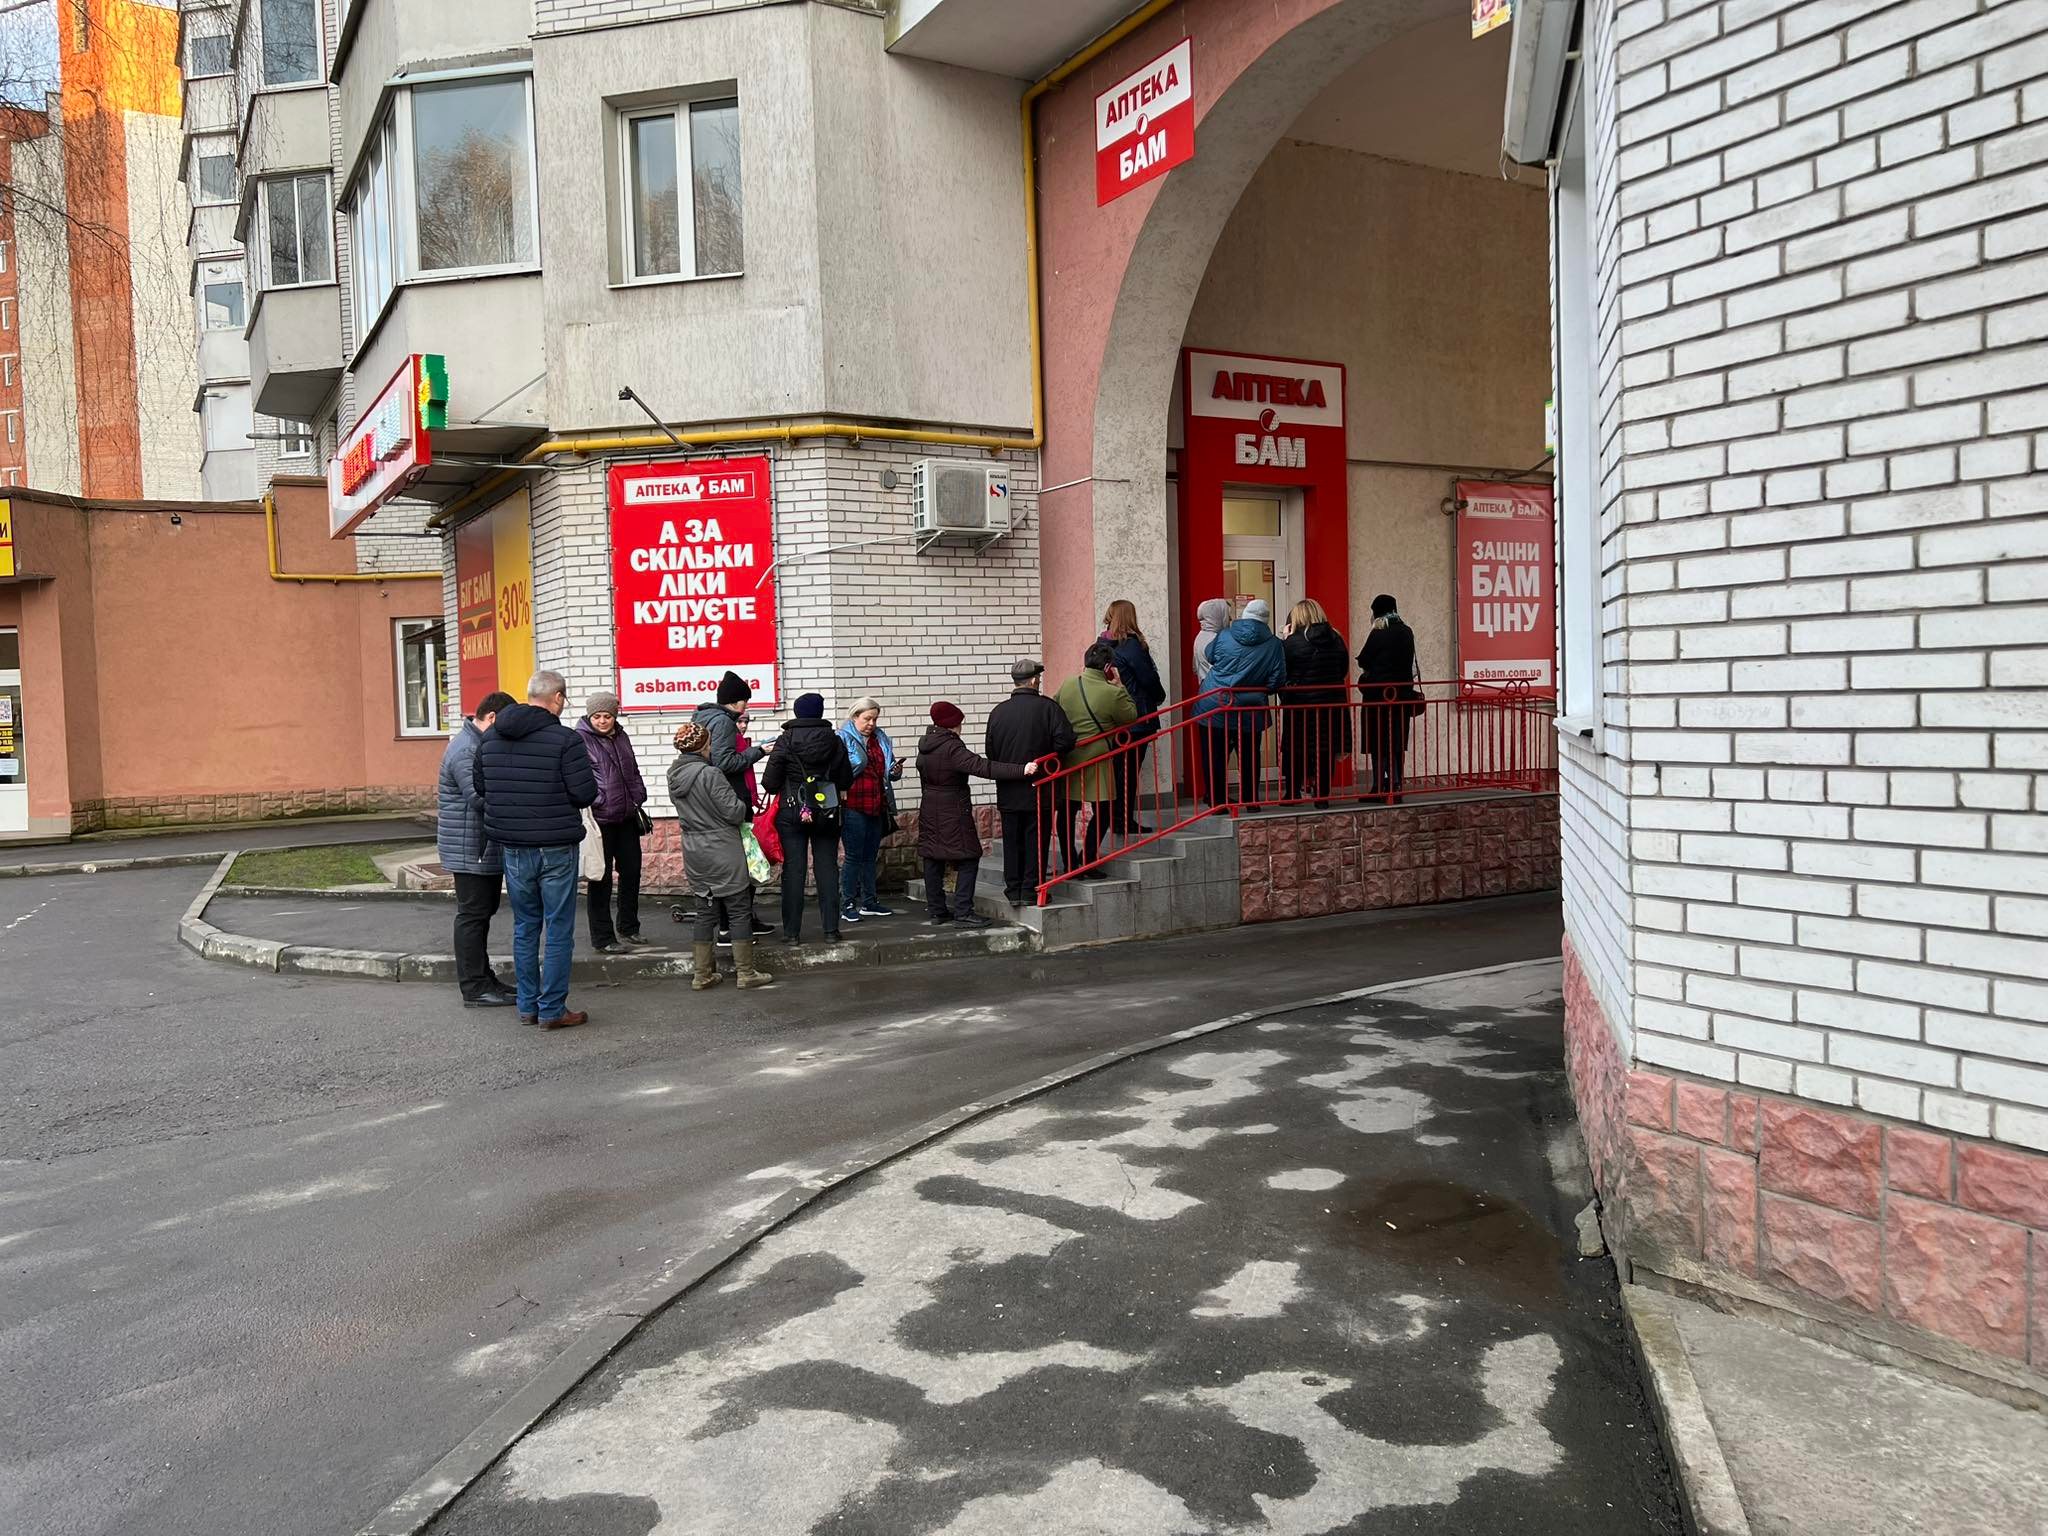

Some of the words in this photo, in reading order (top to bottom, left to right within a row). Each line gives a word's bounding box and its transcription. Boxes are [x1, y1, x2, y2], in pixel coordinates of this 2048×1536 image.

[1106, 62, 1178, 128] АПТЕКА
[1119, 129, 1167, 181] БАМ
[1212, 370, 1327, 408] АПТЕКА
[1235, 433, 1306, 468] БАМ
[635, 483, 691, 497] АПТЕКА
[708, 479, 745, 494] БАМ
[1473, 502, 1506, 514] АПТЕКА
[1517, 504, 1540, 516] БАМ
[658, 520, 679, 544] А
[685, 518, 723, 543] ЗА
[630, 544, 754, 572] СКІЛЬКИ
[1472, 541, 1540, 564] ЗАЦІНИ
[460, 579, 473, 608] БІГ
[473, 571, 492, 604] БАМ
[658, 571, 726, 597] ЛІКИ
[1472, 565, 1540, 597] БАМ
[634, 597, 757, 624] КУПУЄТЕ
[1472, 603, 1540, 638] ЦІНУ
[462, 630, 494, 661] ЗНИЖКИ
[668, 625, 723, 650] ВИ?
[635, 678, 760, 693] asbam.coa
[1473, 666, 1542, 679] asbam.com.ua
